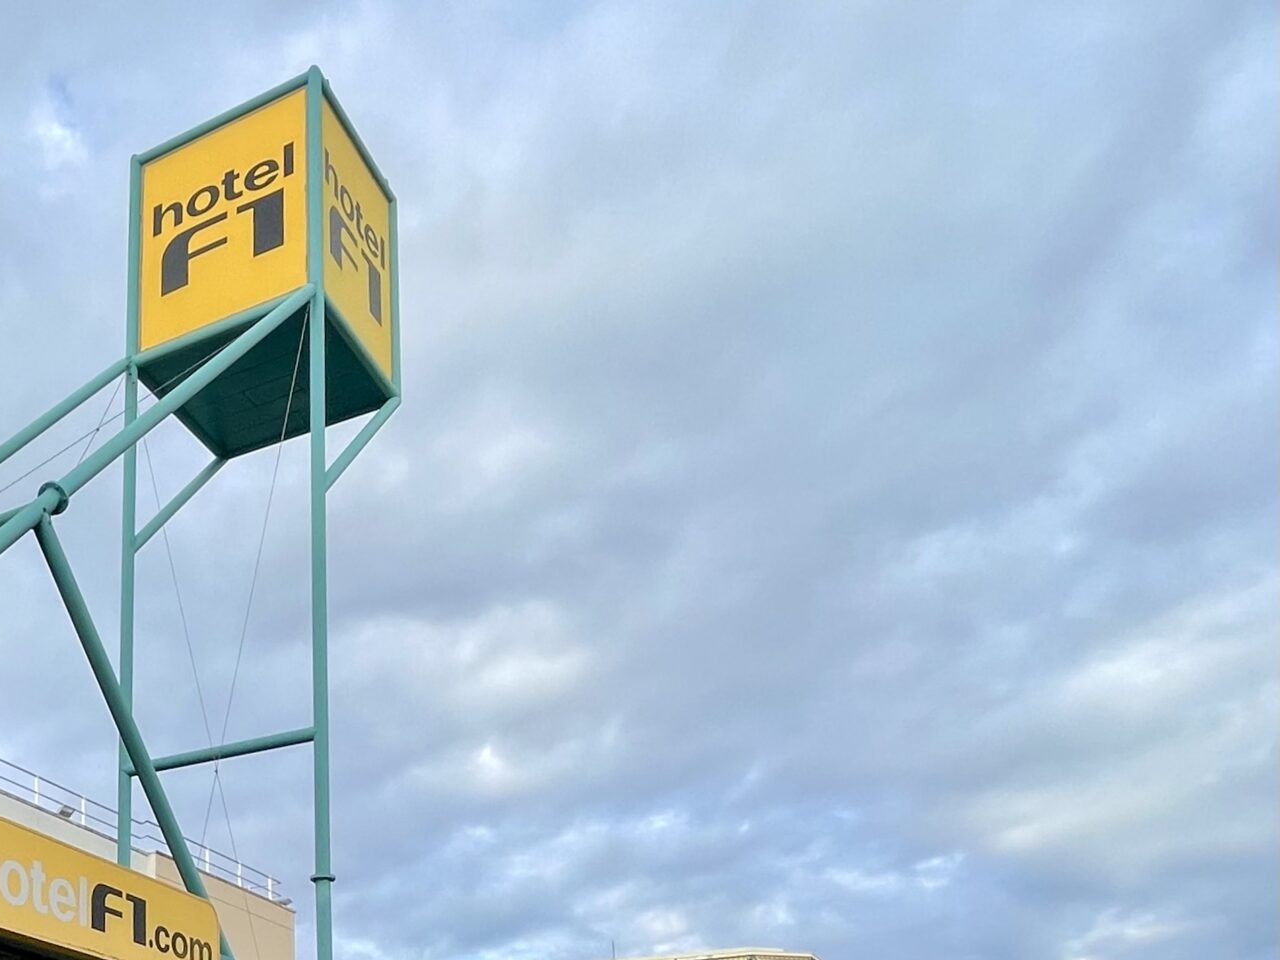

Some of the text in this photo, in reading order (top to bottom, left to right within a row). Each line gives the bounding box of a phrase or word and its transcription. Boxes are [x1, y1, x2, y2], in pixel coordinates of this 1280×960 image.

[153, 141, 294, 237] hotel
[161, 187, 284, 297] F1
[324, 146, 385, 269] hotel
[329, 204, 382, 327] F1
